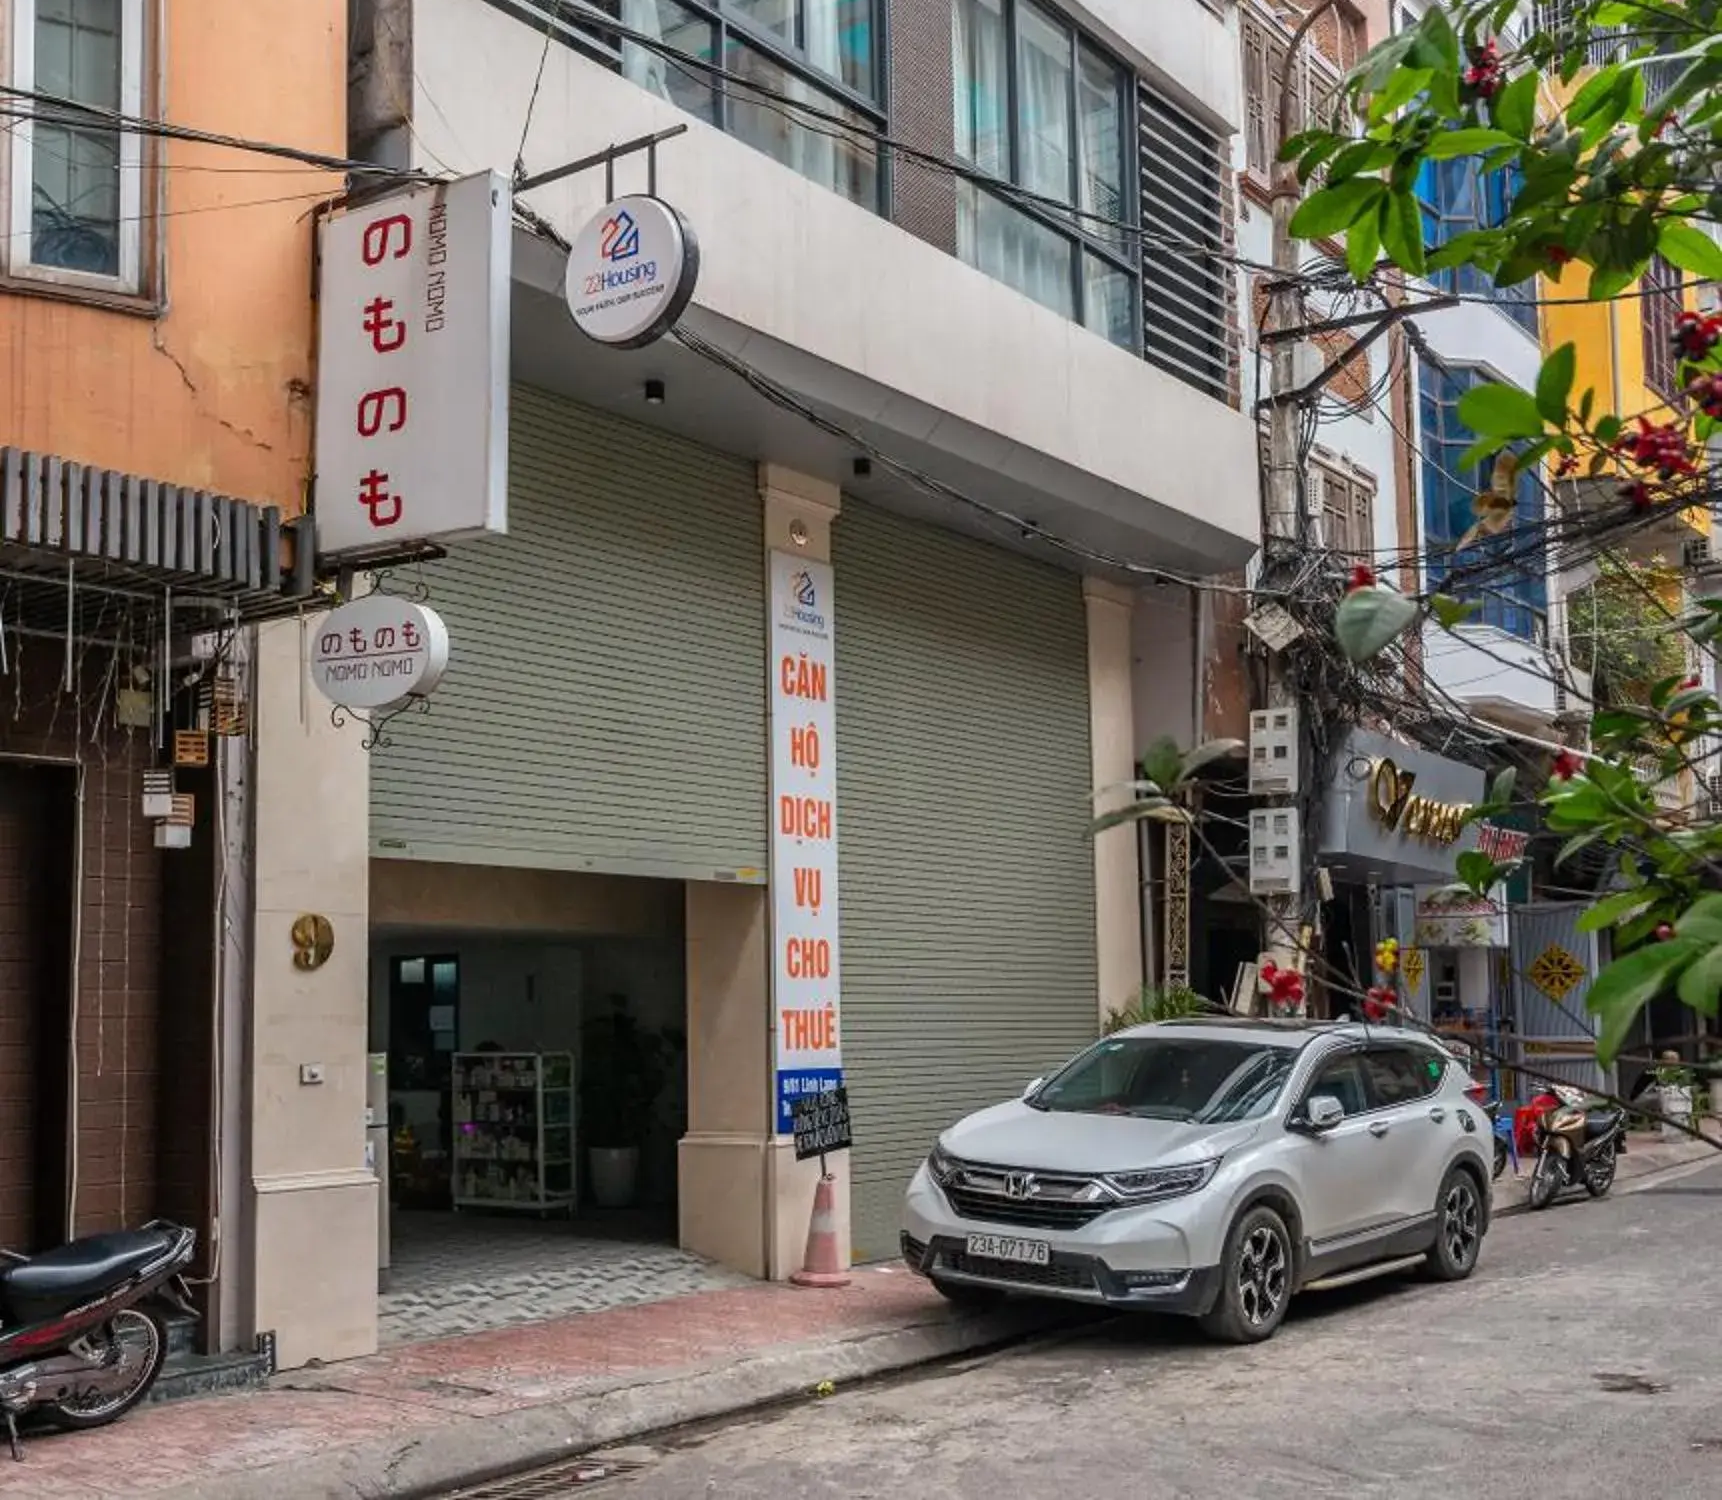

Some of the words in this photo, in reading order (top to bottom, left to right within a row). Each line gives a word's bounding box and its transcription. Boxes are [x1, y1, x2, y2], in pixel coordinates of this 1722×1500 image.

[426, 271, 445, 333] NOMO
[357, 213, 412, 528] のものも
[321, 620, 420, 653] のものも
[325, 664, 367, 682] NOMO
[372, 658, 413, 677] NOMO
[781, 651, 827, 702] CĂN
[790, 721, 820, 778] HỘ
[780, 795, 831, 845] DỊCH
[793, 867, 821, 916] VỤ
[786, 937, 830, 979] CHO
[781, 1001, 837, 1050] THUÊ
